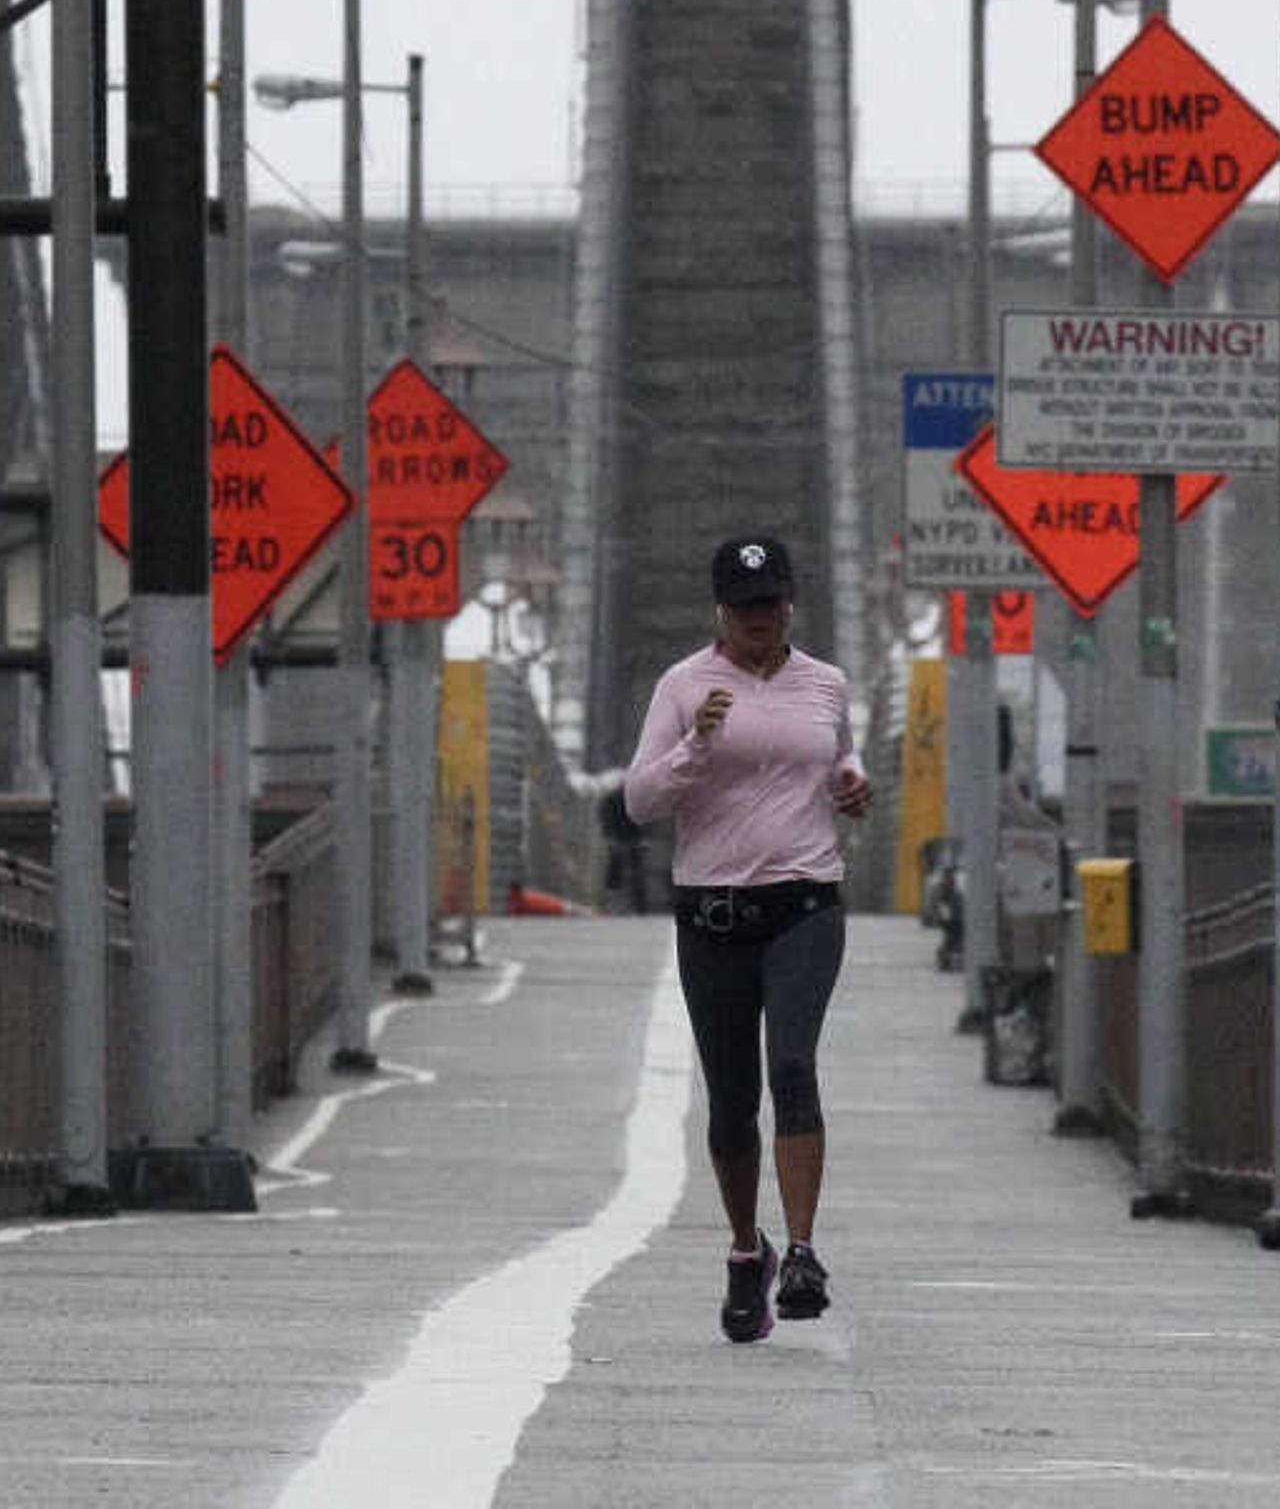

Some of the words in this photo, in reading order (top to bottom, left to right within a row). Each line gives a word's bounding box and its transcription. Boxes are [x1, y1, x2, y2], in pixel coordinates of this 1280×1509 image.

[1100, 94, 1220, 135] BUMP
[1090, 154, 1240, 194] AHEAD
[1049, 320, 1266, 360] WARNING!
[380, 533, 448, 580] 30
